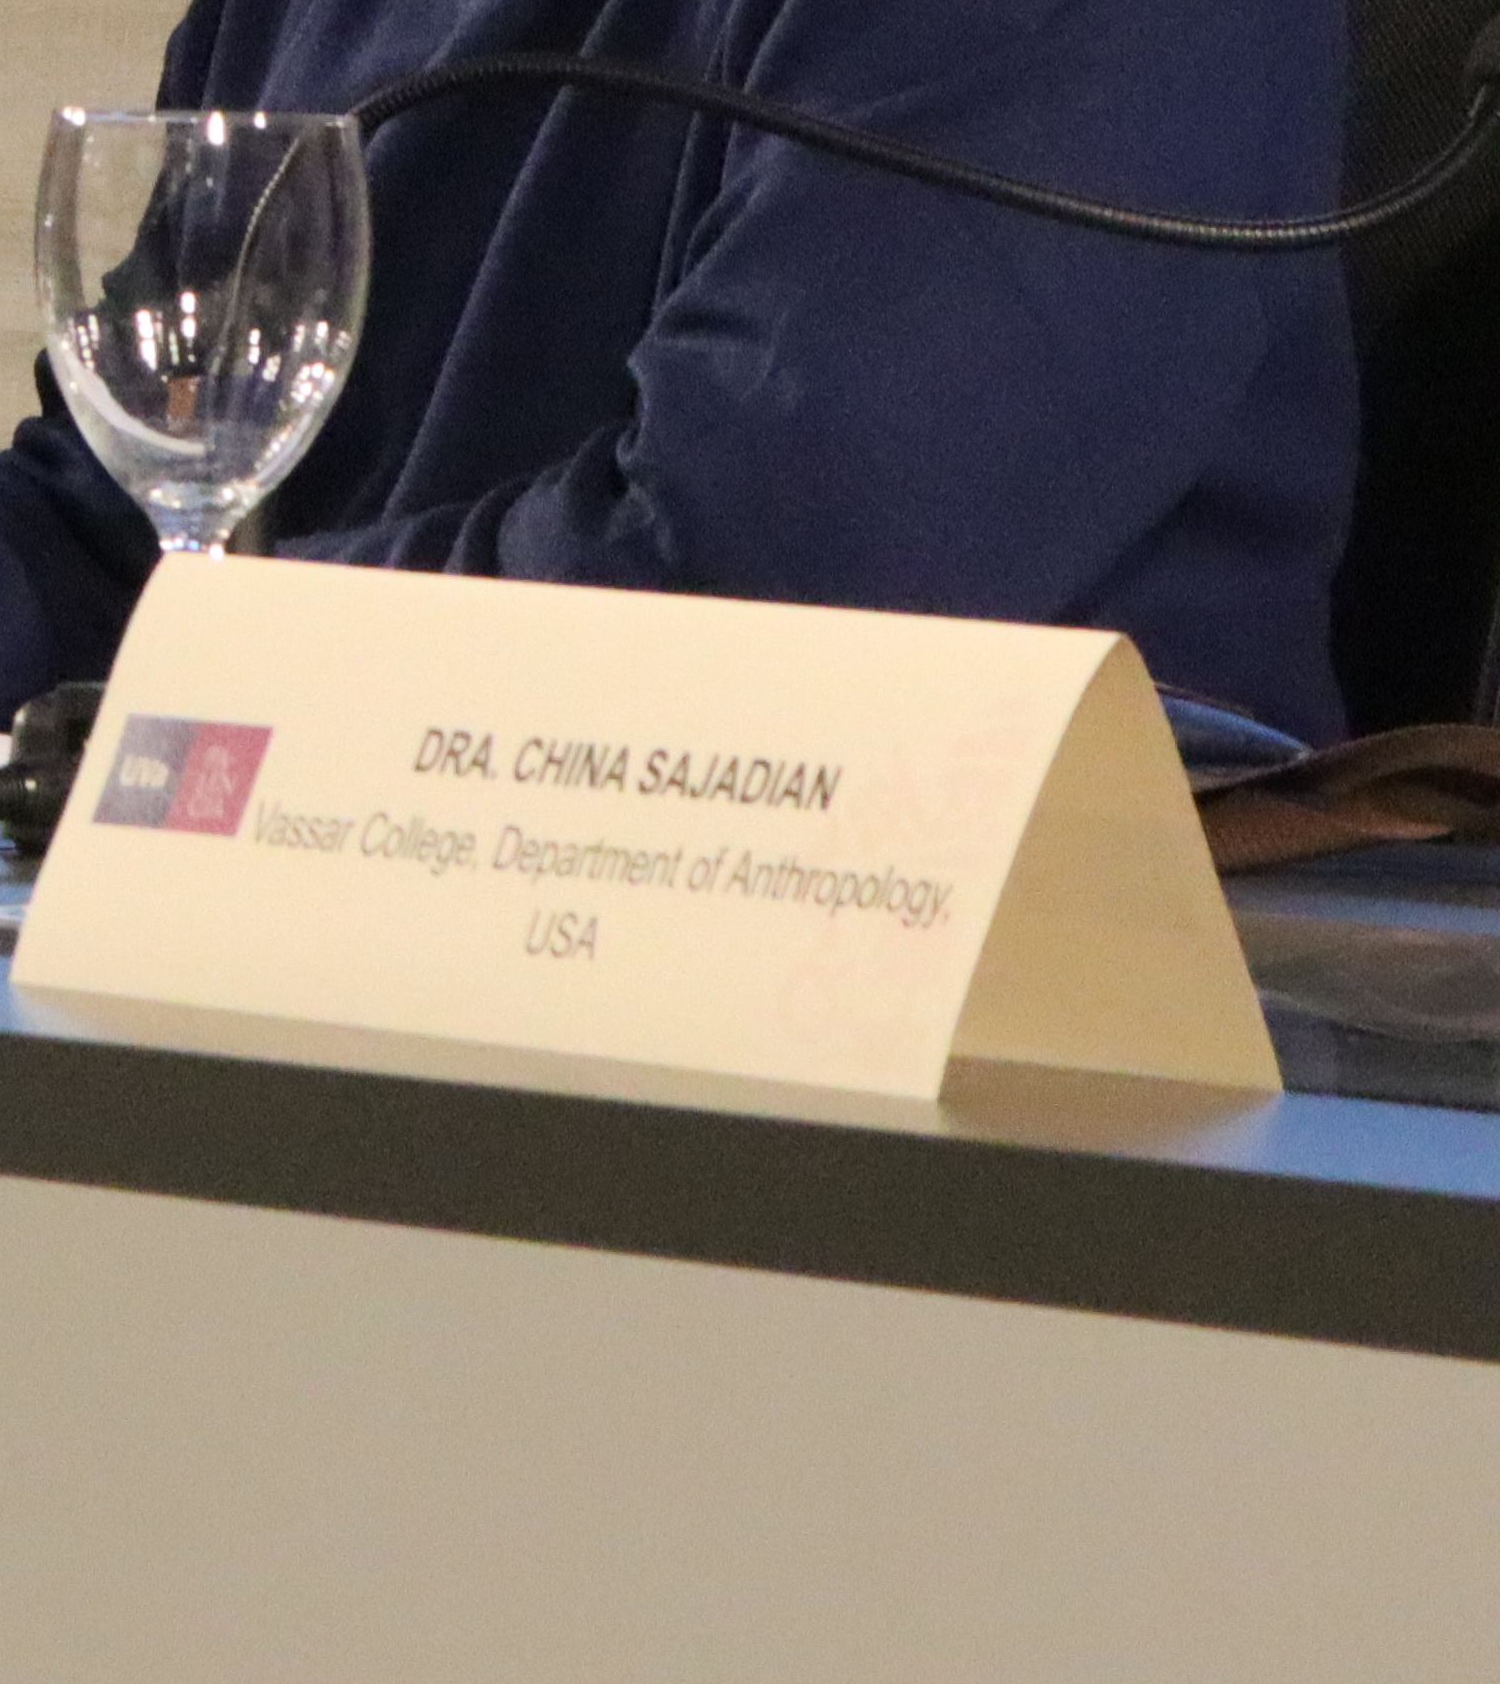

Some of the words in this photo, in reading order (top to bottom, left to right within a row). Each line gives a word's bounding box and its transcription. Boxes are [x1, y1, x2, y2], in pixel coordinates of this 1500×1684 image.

[414, 728, 497, 779] DRA.
[514, 737, 630, 793] CHINA
[638, 747, 842, 812] SAJADIAN
[254, 801, 355, 856] Vassar
[492, 825, 683, 889] Department
[688, 849, 728, 892] of
[731, 851, 953, 930] Anthropology,
[525, 909, 600, 961] USA
